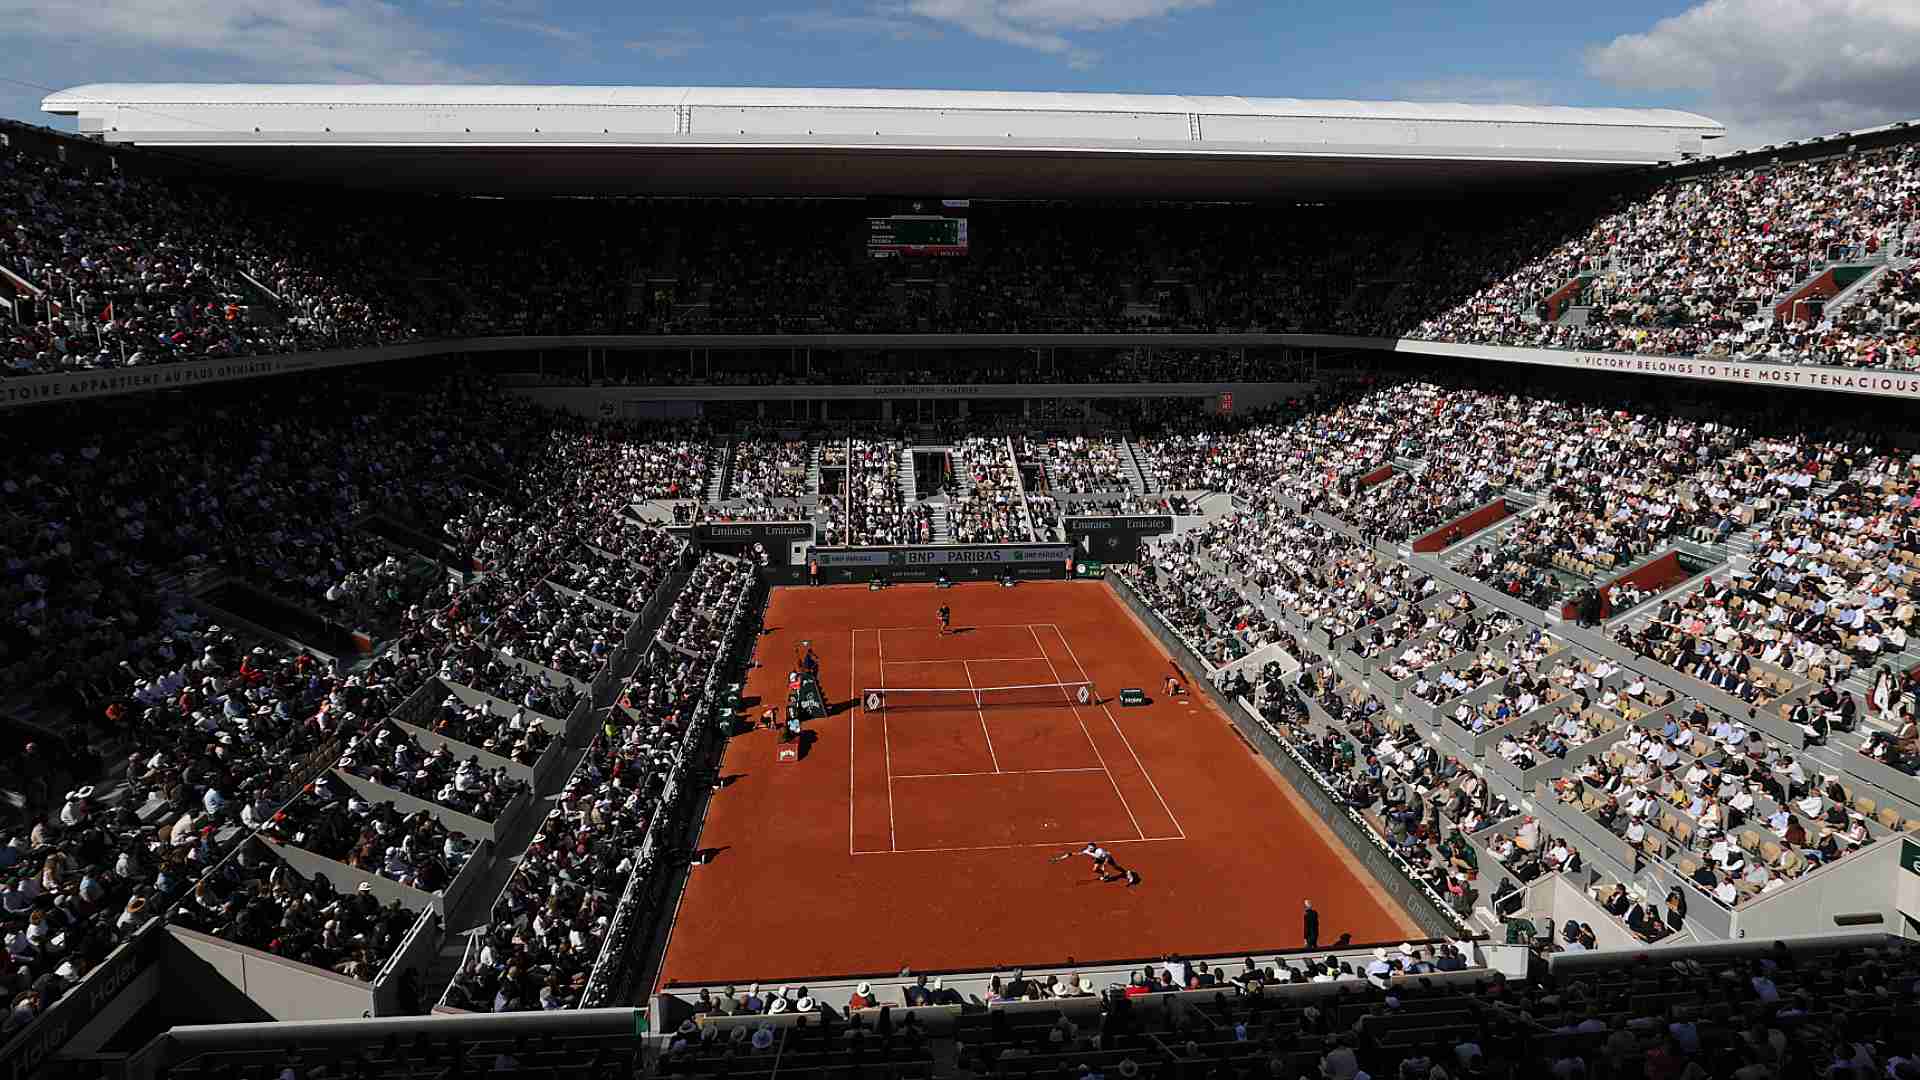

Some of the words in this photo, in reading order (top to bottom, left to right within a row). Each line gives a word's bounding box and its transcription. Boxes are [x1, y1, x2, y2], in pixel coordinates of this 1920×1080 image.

[1584, 357, 1631, 369] VICTORY
[1637, 360, 1693, 374] BELONGS
[1701, 365, 1716, 376] TO
[1724, 367, 1750, 379] THE
[1758, 370, 1801, 382] MOST
[1810, 374, 1919, 393] TENACIOUS
[909, 552, 935, 563] BNP
[947, 551, 1000, 562] PARIBAS
